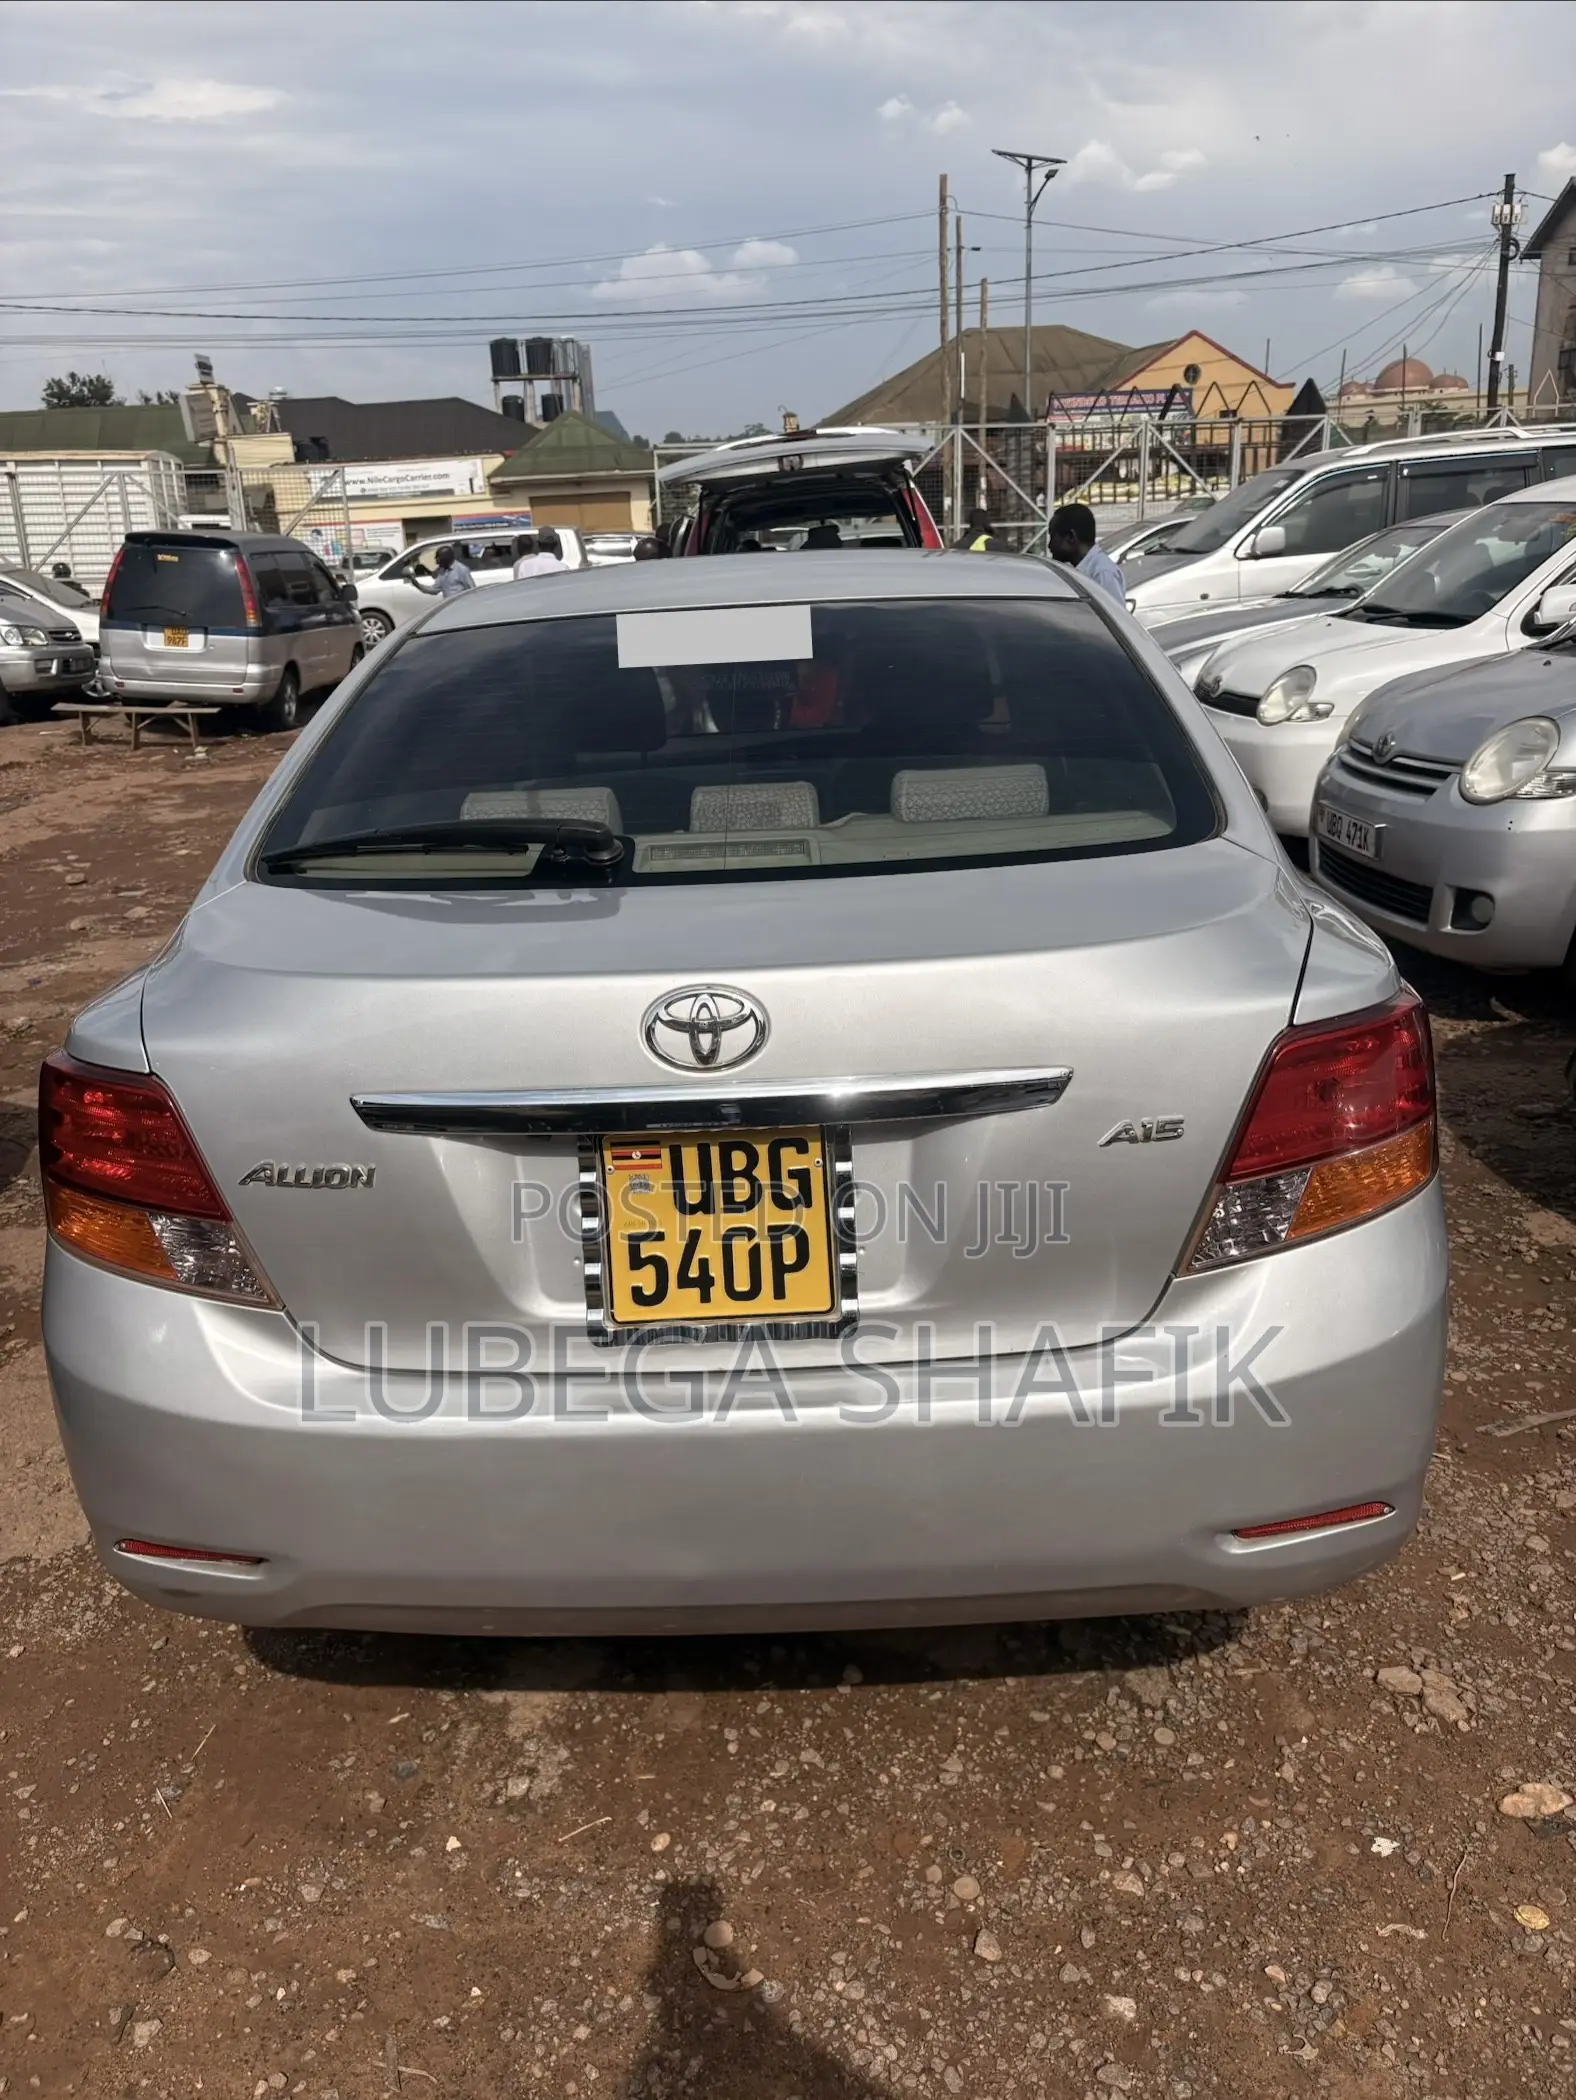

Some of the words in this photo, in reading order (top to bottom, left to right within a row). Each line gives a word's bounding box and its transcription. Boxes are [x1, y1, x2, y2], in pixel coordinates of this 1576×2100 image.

[1097, 1114, 1184, 1147] A15
[238, 1159, 376, 1189] ALLION
[669, 1138, 812, 1216] UBG
[628, 1223, 810, 1307] 540P
